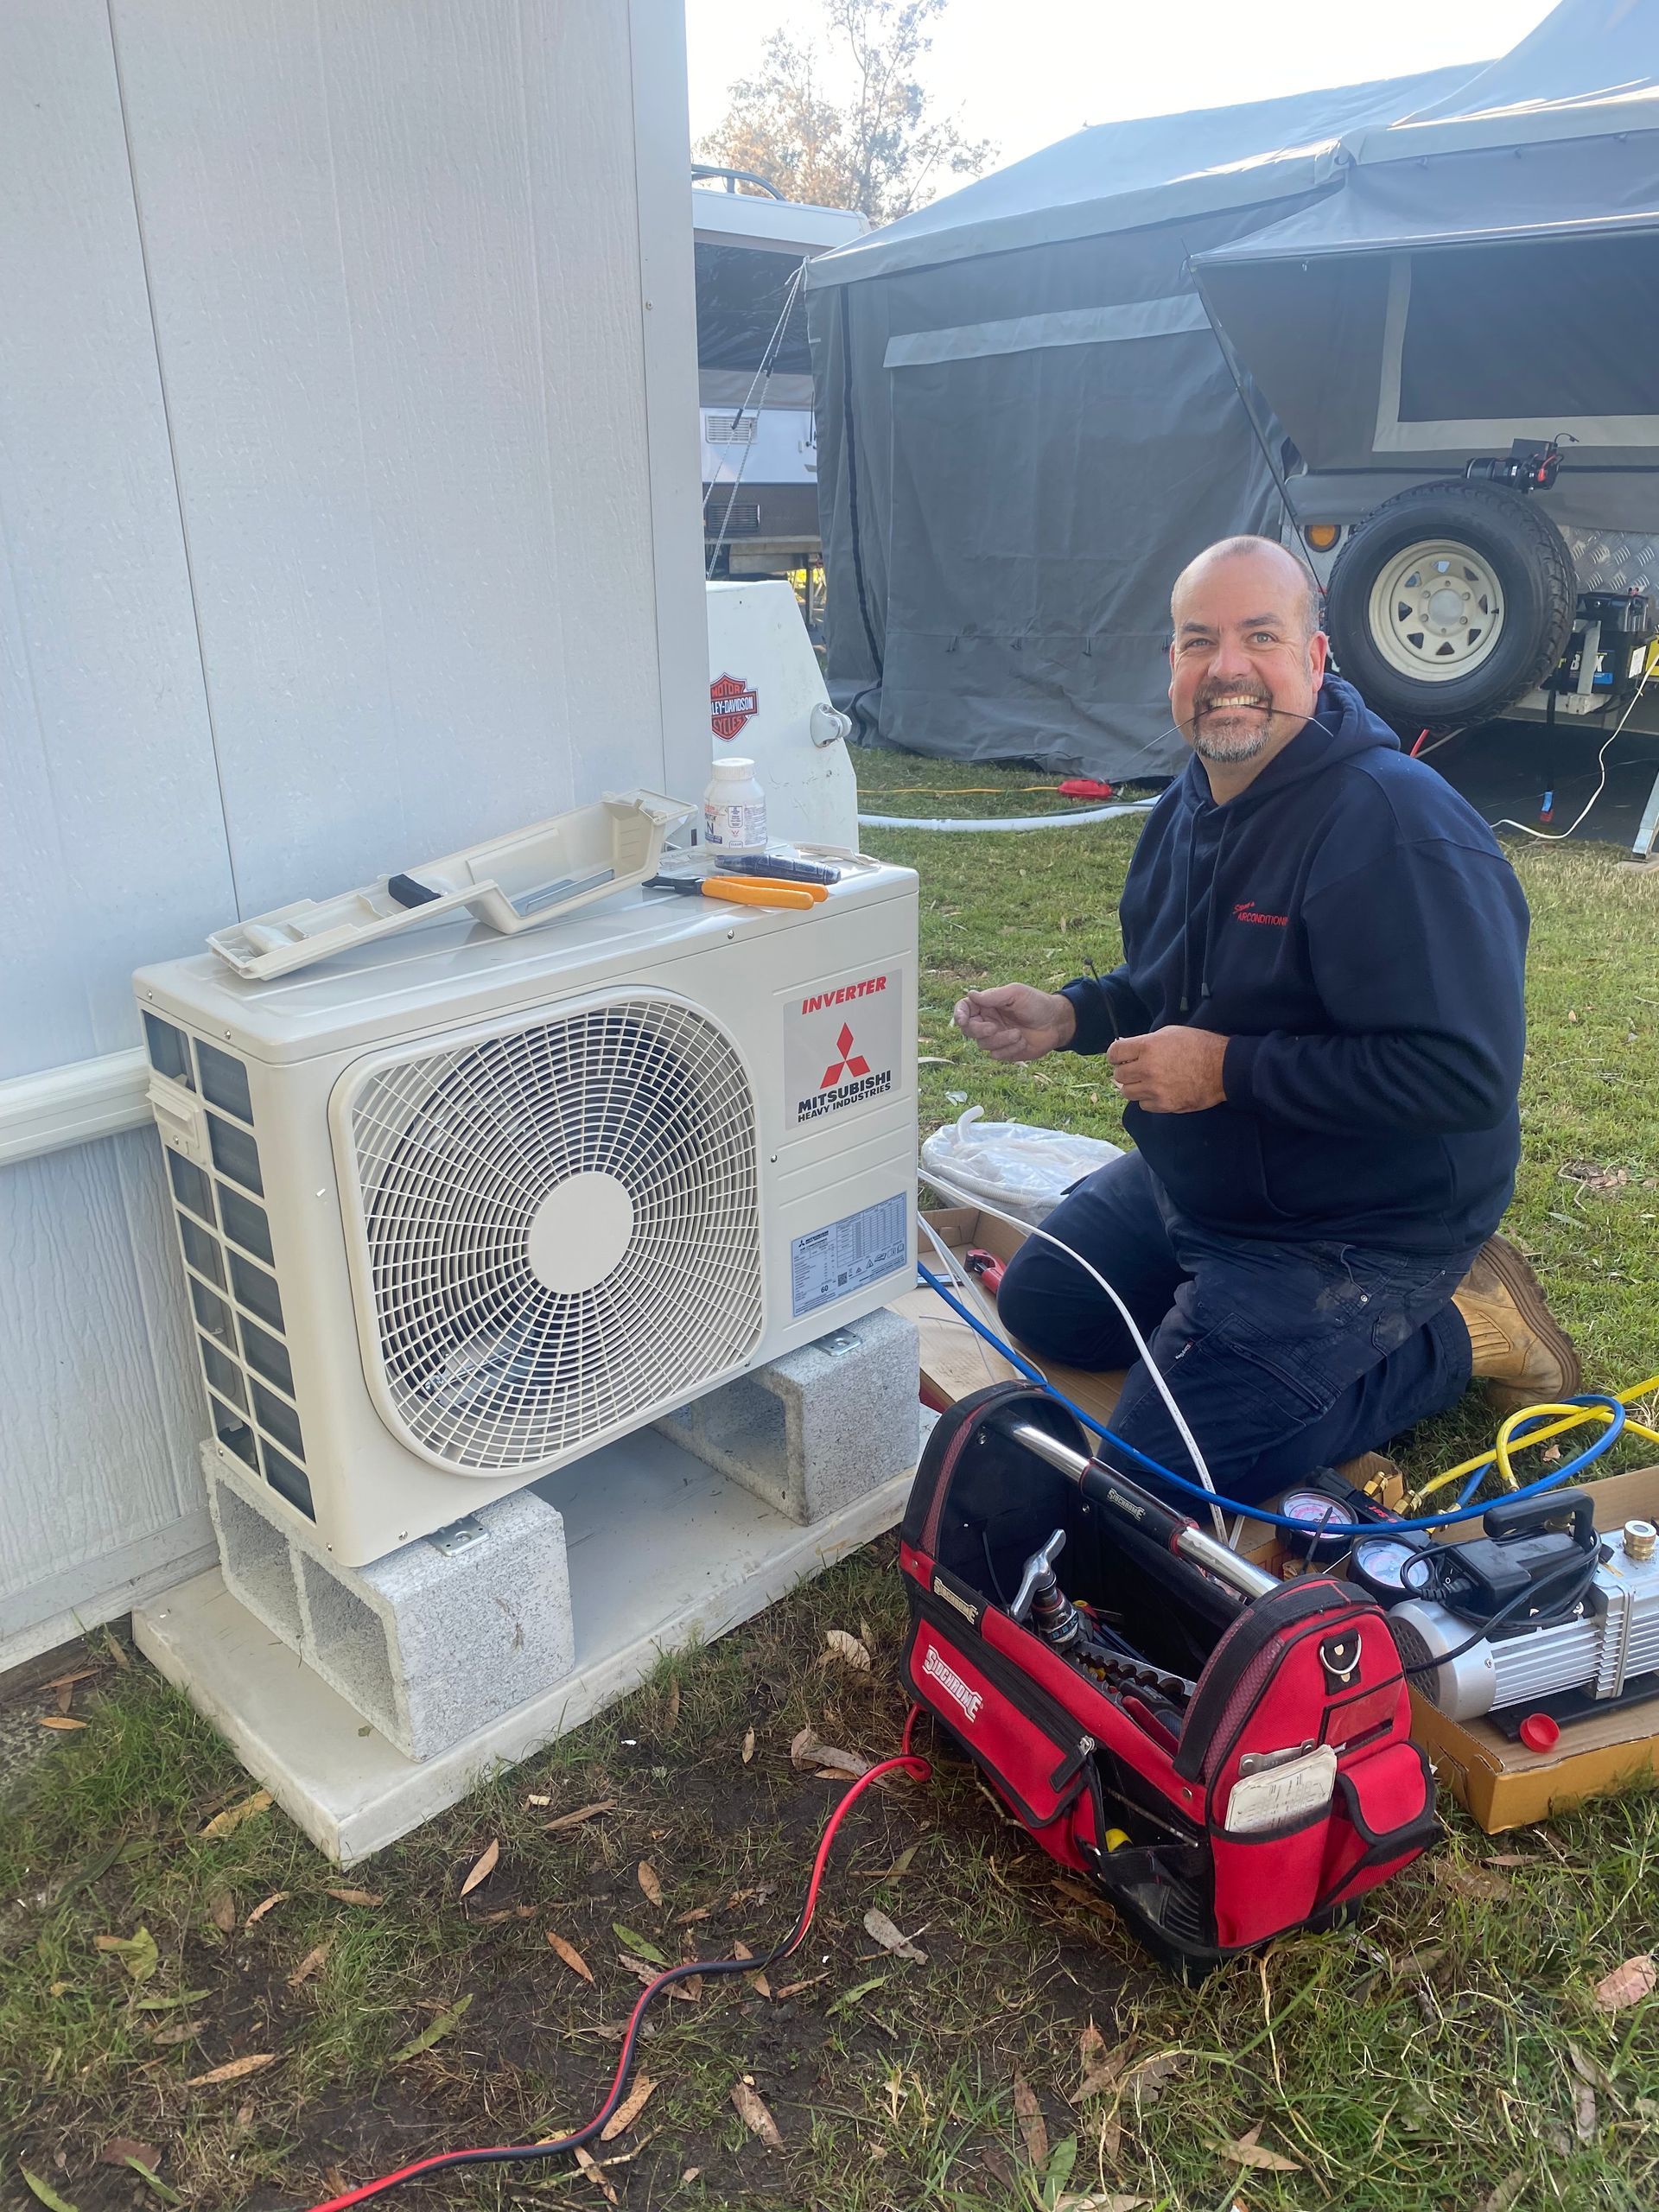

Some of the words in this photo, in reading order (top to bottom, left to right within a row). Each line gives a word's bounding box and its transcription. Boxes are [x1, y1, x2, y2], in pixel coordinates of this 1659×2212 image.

[1570, 653, 1605, 672] BX
[711, 682, 741, 697] MOTOR
[712, 696, 753, 715] LEY-DAVIDSON
[713, 716, 742, 734] CYCLES
[802, 976, 887, 1014] INVERTER
[798, 1070, 891, 1114] MITSUBISHI
[798, 1105, 830, 1122] HEAVY
[832, 1083, 891, 1110] INDUSTRIES
[1107, 1487, 1146, 1521] SIDCHROME
[922, 1644, 983, 1723] SIDCHROME
